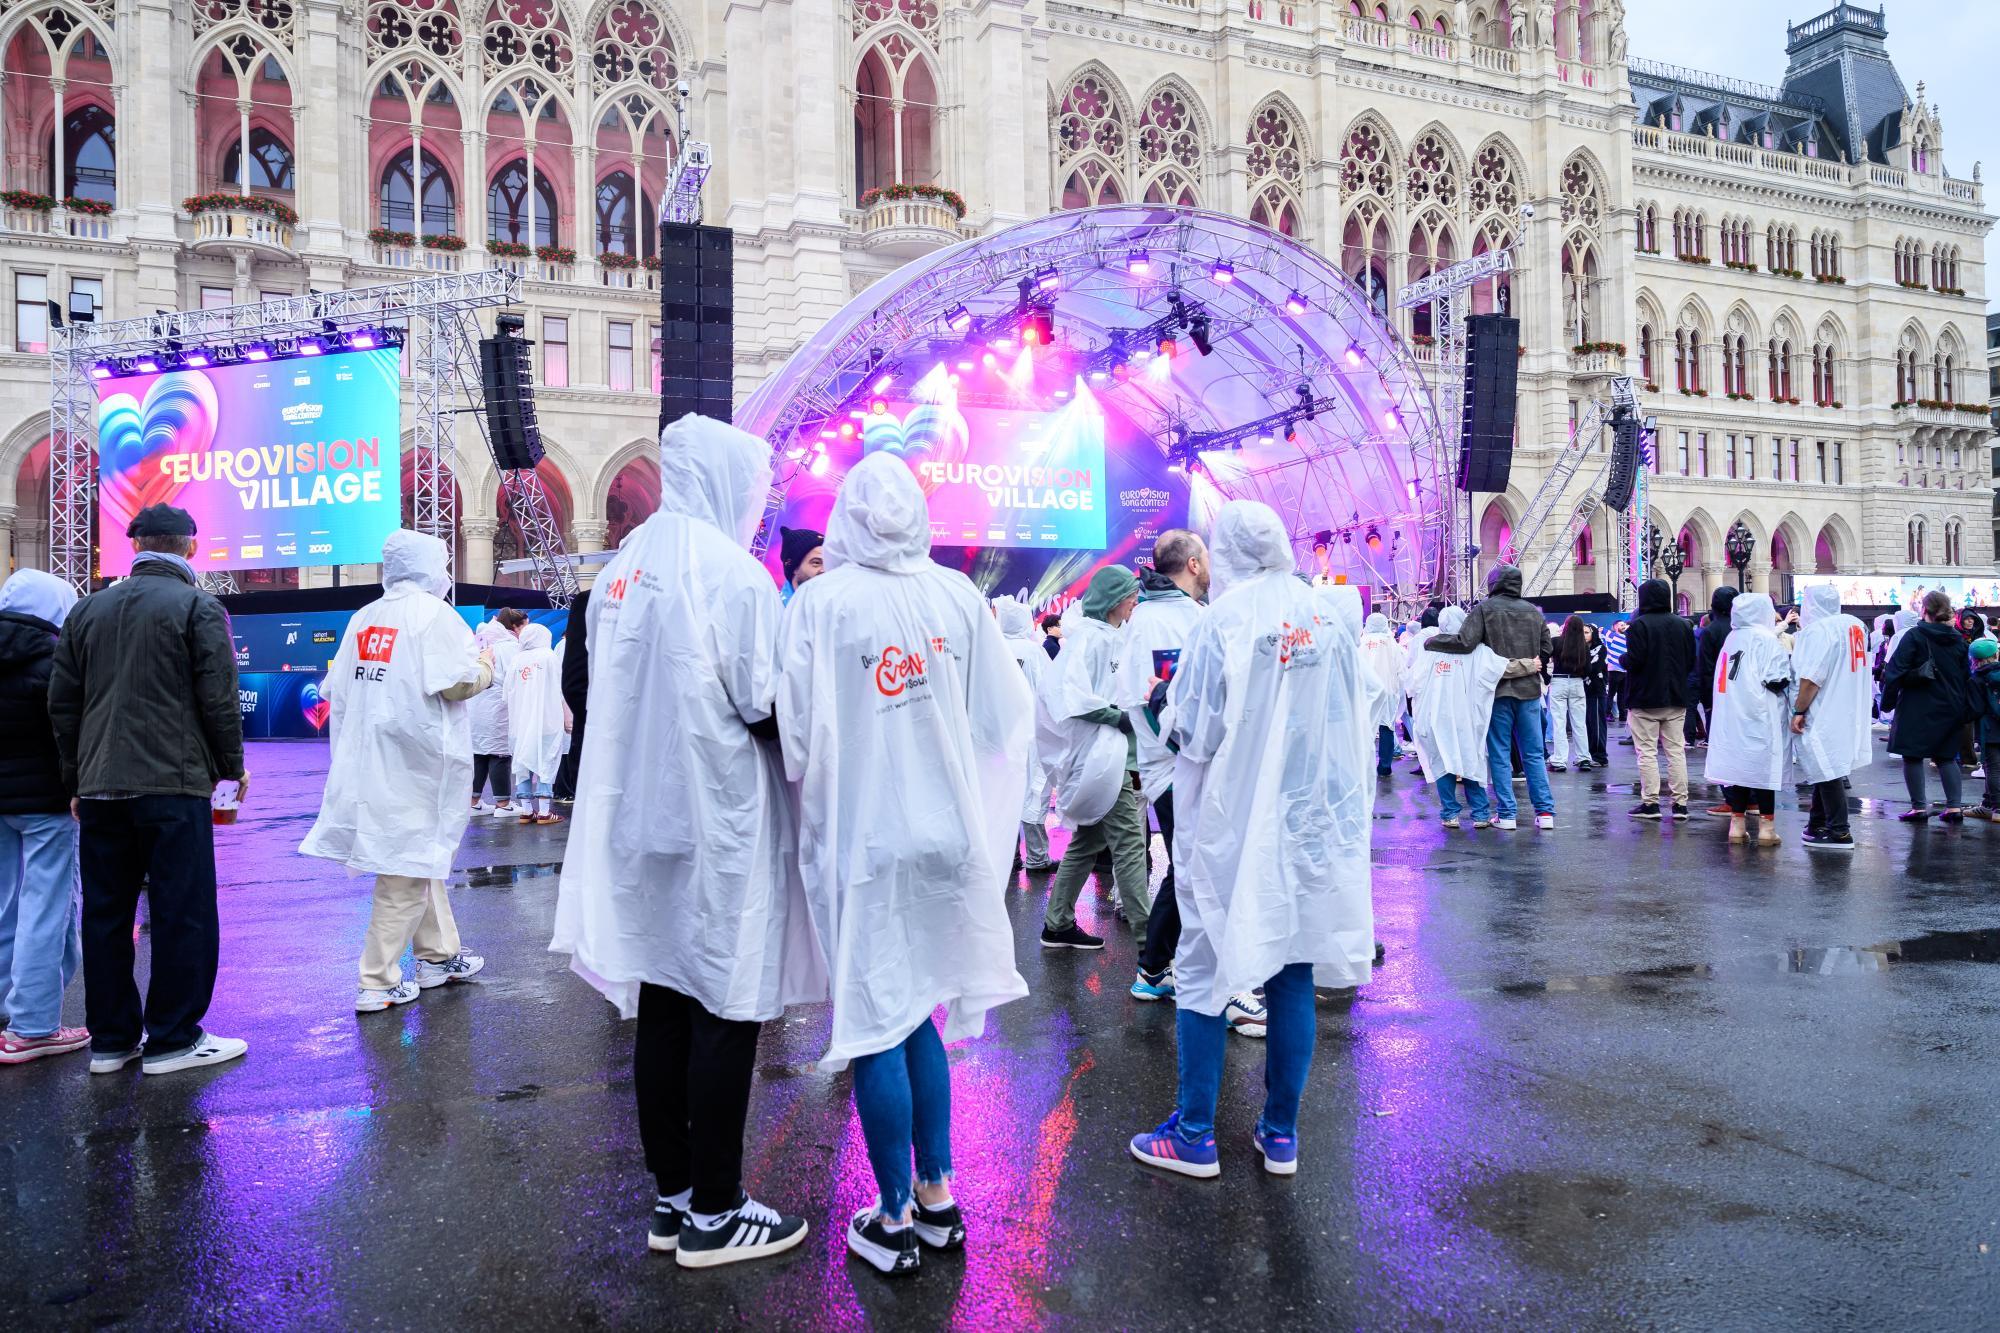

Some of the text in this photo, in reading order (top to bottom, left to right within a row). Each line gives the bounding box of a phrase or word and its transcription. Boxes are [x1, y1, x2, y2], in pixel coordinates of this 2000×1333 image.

[161, 438, 379, 488] EUROVISION
[920, 461, 1092, 491] EUROVISION
[239, 470, 382, 510] VILLAGE
[986, 487, 1093, 511] VILLAGE
[361, 633, 393, 655] RF
